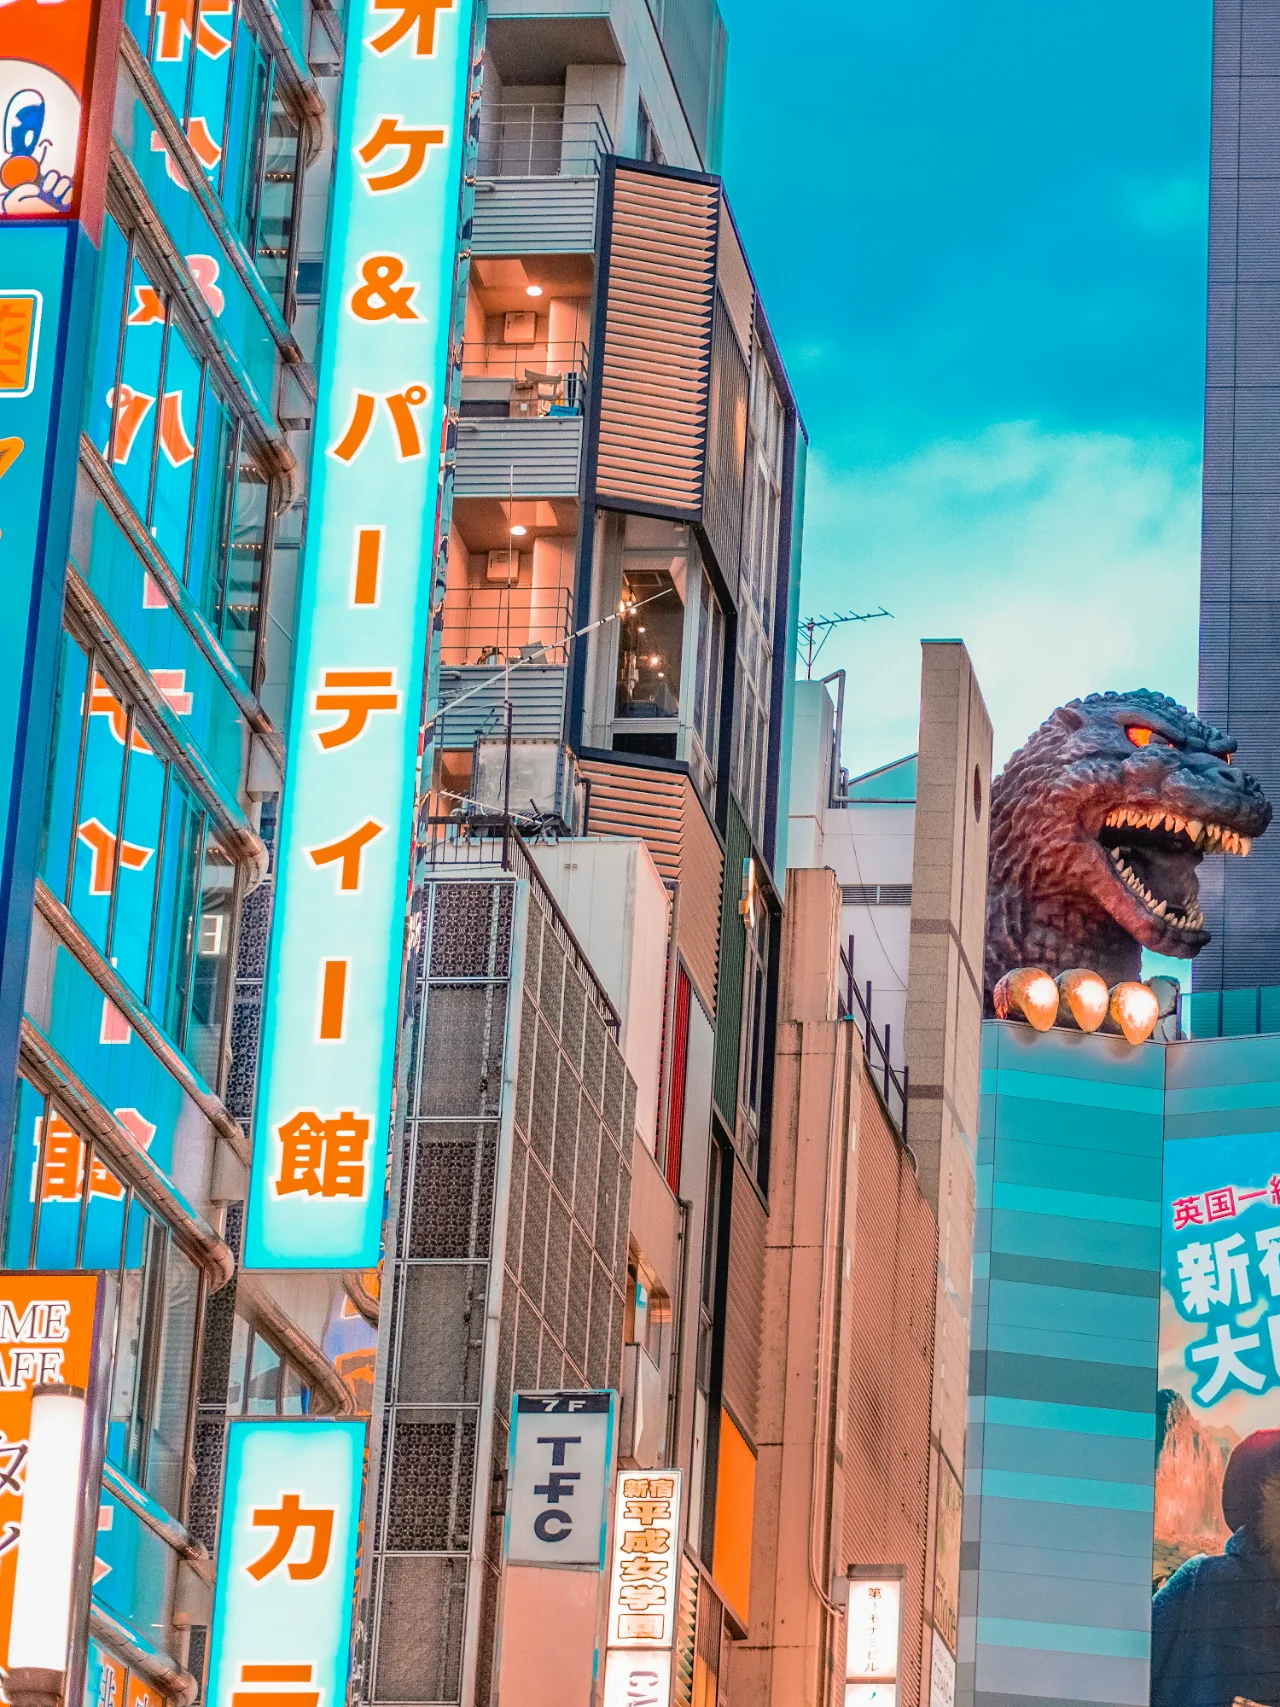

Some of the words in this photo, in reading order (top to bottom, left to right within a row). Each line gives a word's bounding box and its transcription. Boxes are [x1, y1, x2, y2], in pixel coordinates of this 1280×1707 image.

[541, 1400, 586, 1412] 7F
[533, 1436, 581, 1543] TFC
[623, 1478, 674, 1499] 新宿
